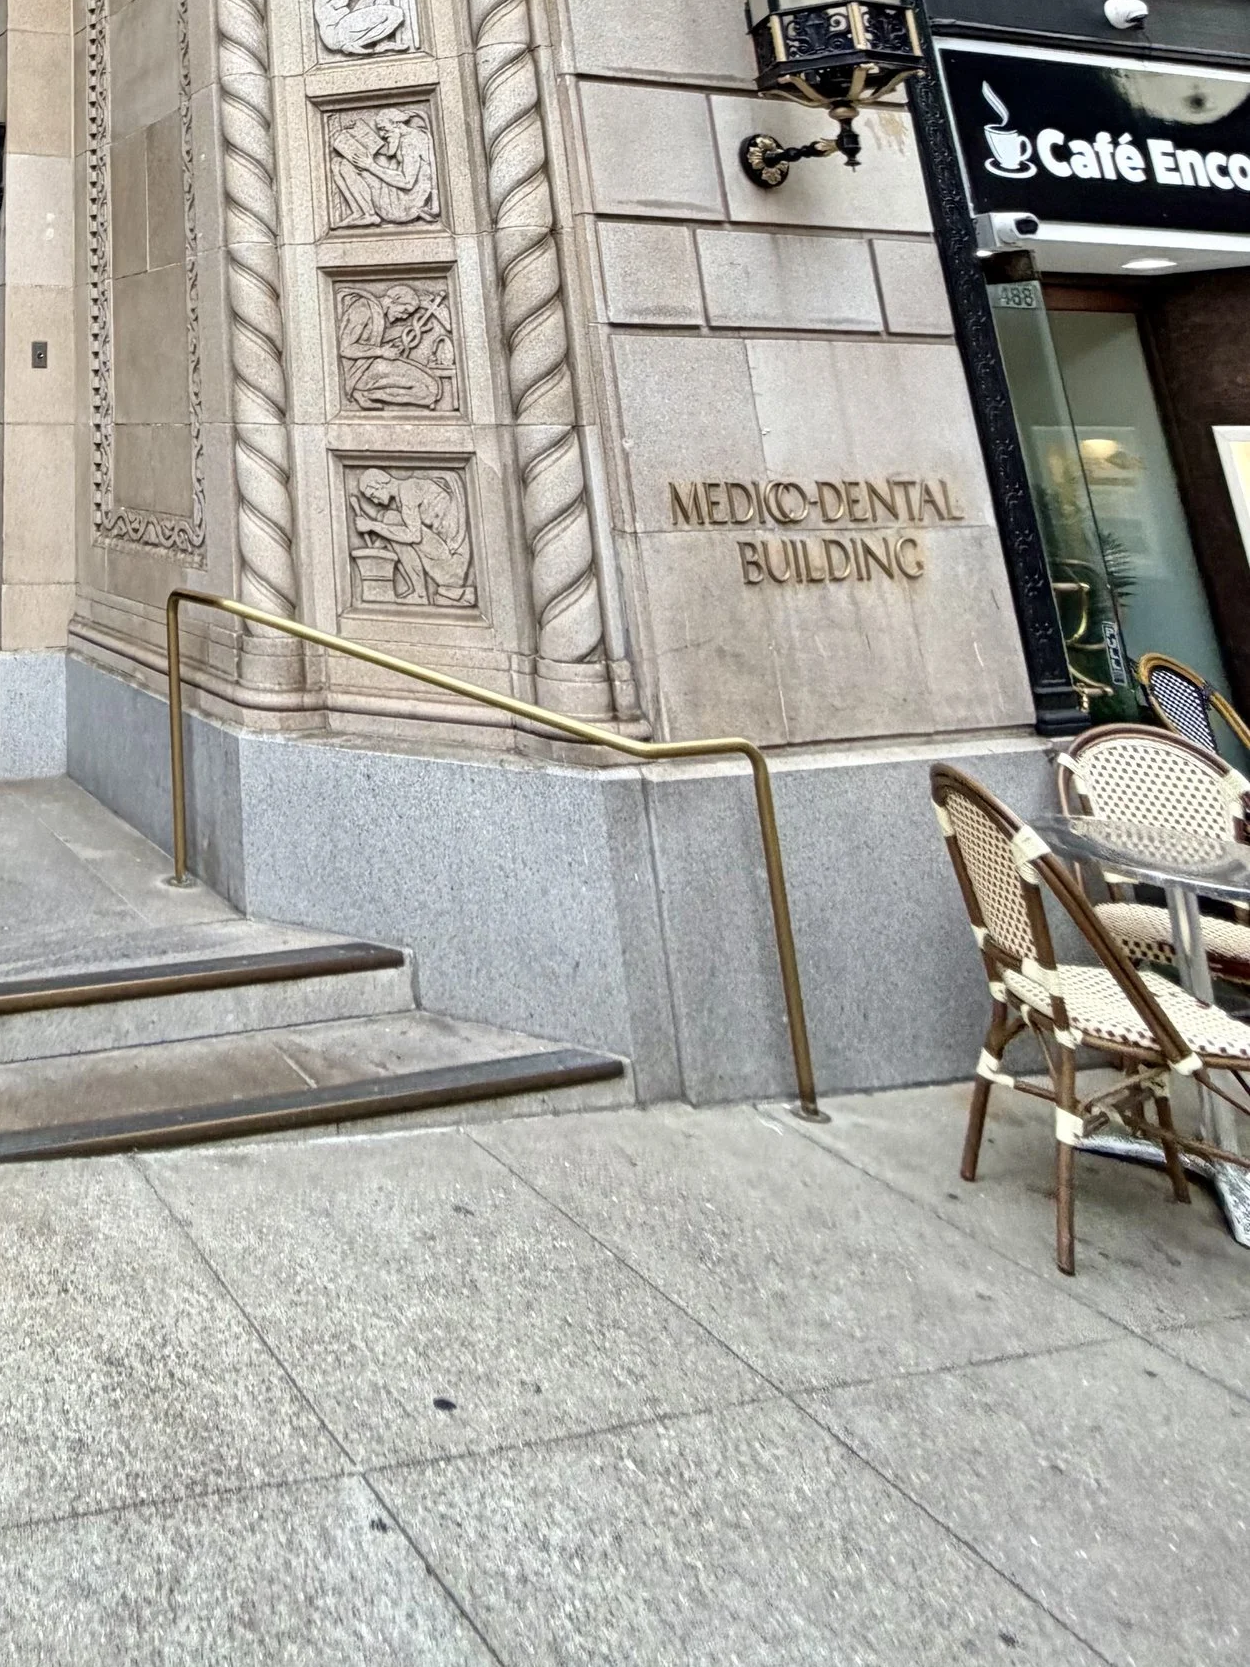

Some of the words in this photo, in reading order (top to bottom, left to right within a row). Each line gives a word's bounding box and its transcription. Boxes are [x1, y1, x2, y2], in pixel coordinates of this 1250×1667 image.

[1036, 127, 1147, 183] Café
[999, 285, 1034, 307] 488
[667, 478, 966, 526] MEDICO-DENTAL
[736, 536, 925, 585] BUILDING
